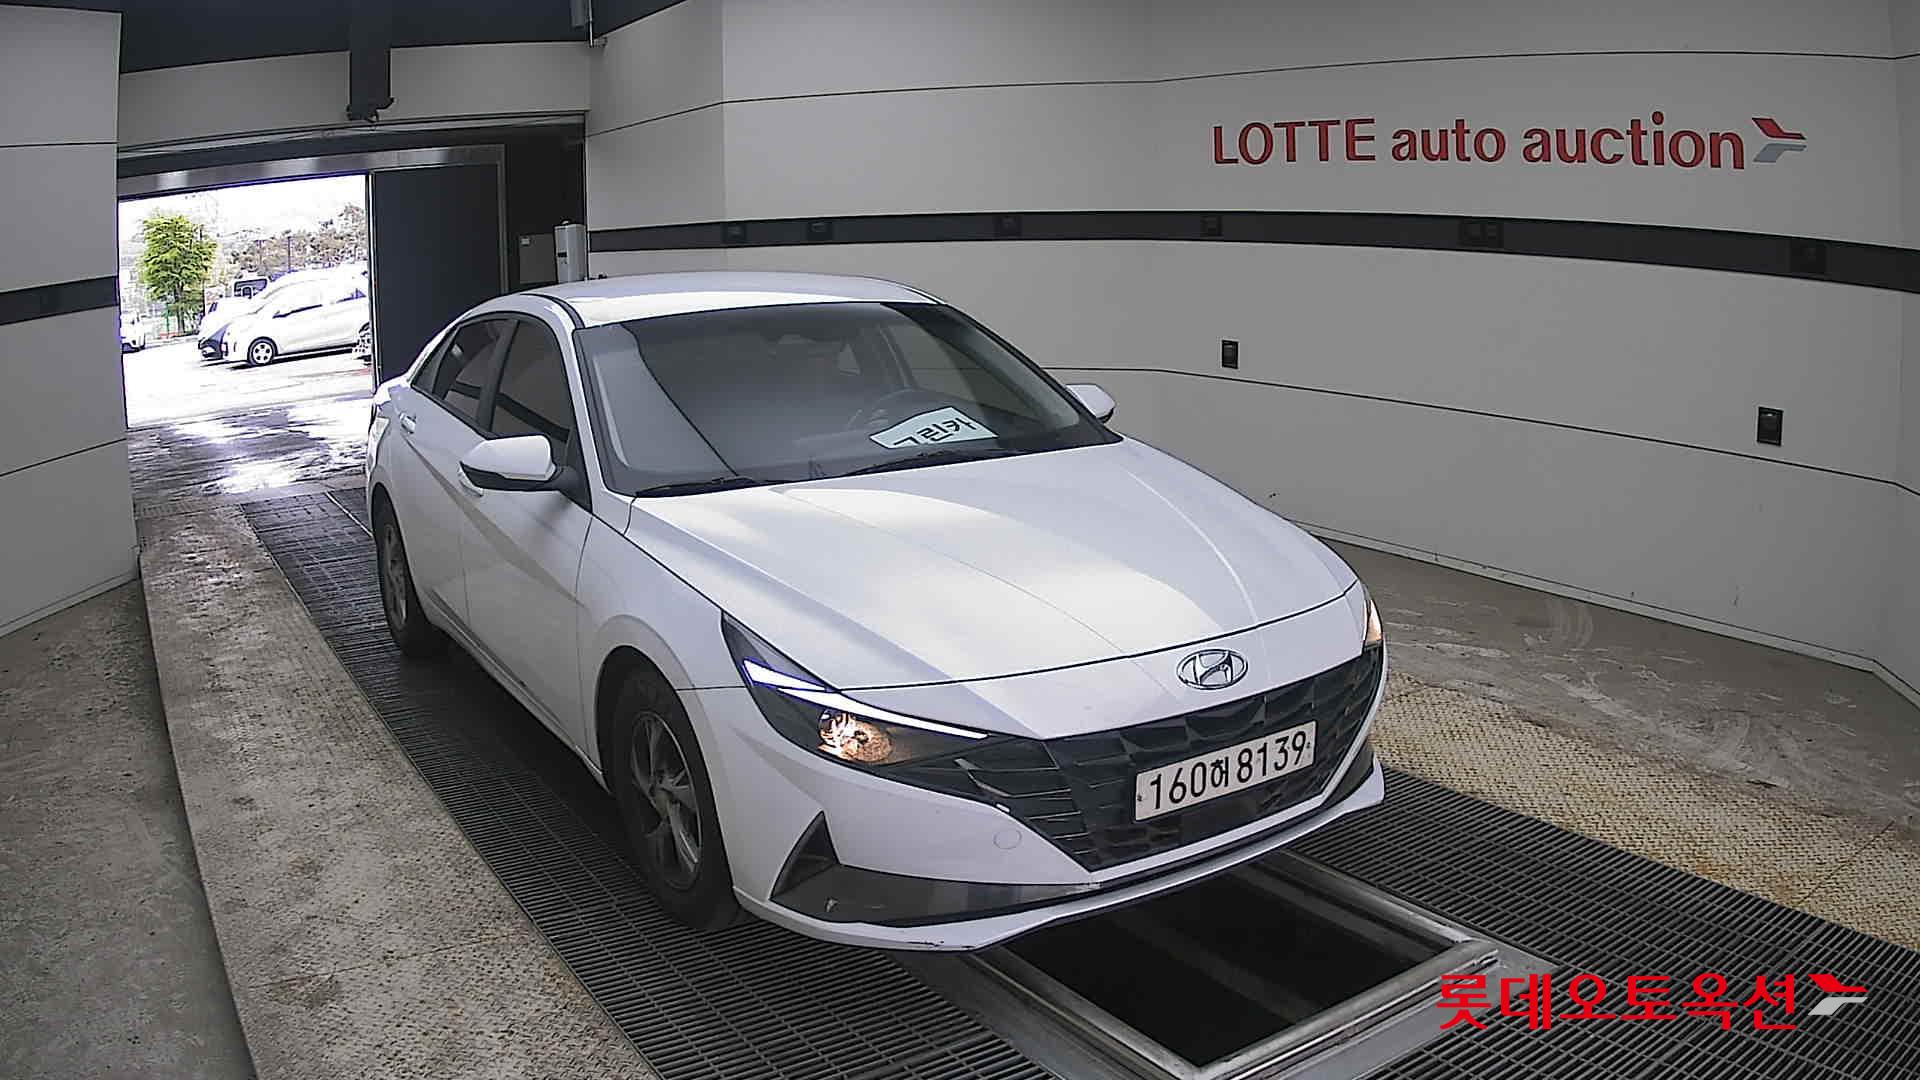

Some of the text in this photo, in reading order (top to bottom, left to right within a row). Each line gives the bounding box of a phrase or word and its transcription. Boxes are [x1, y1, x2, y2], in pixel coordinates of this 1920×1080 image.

[1213, 111, 1745, 170] LOTTE auto auction
